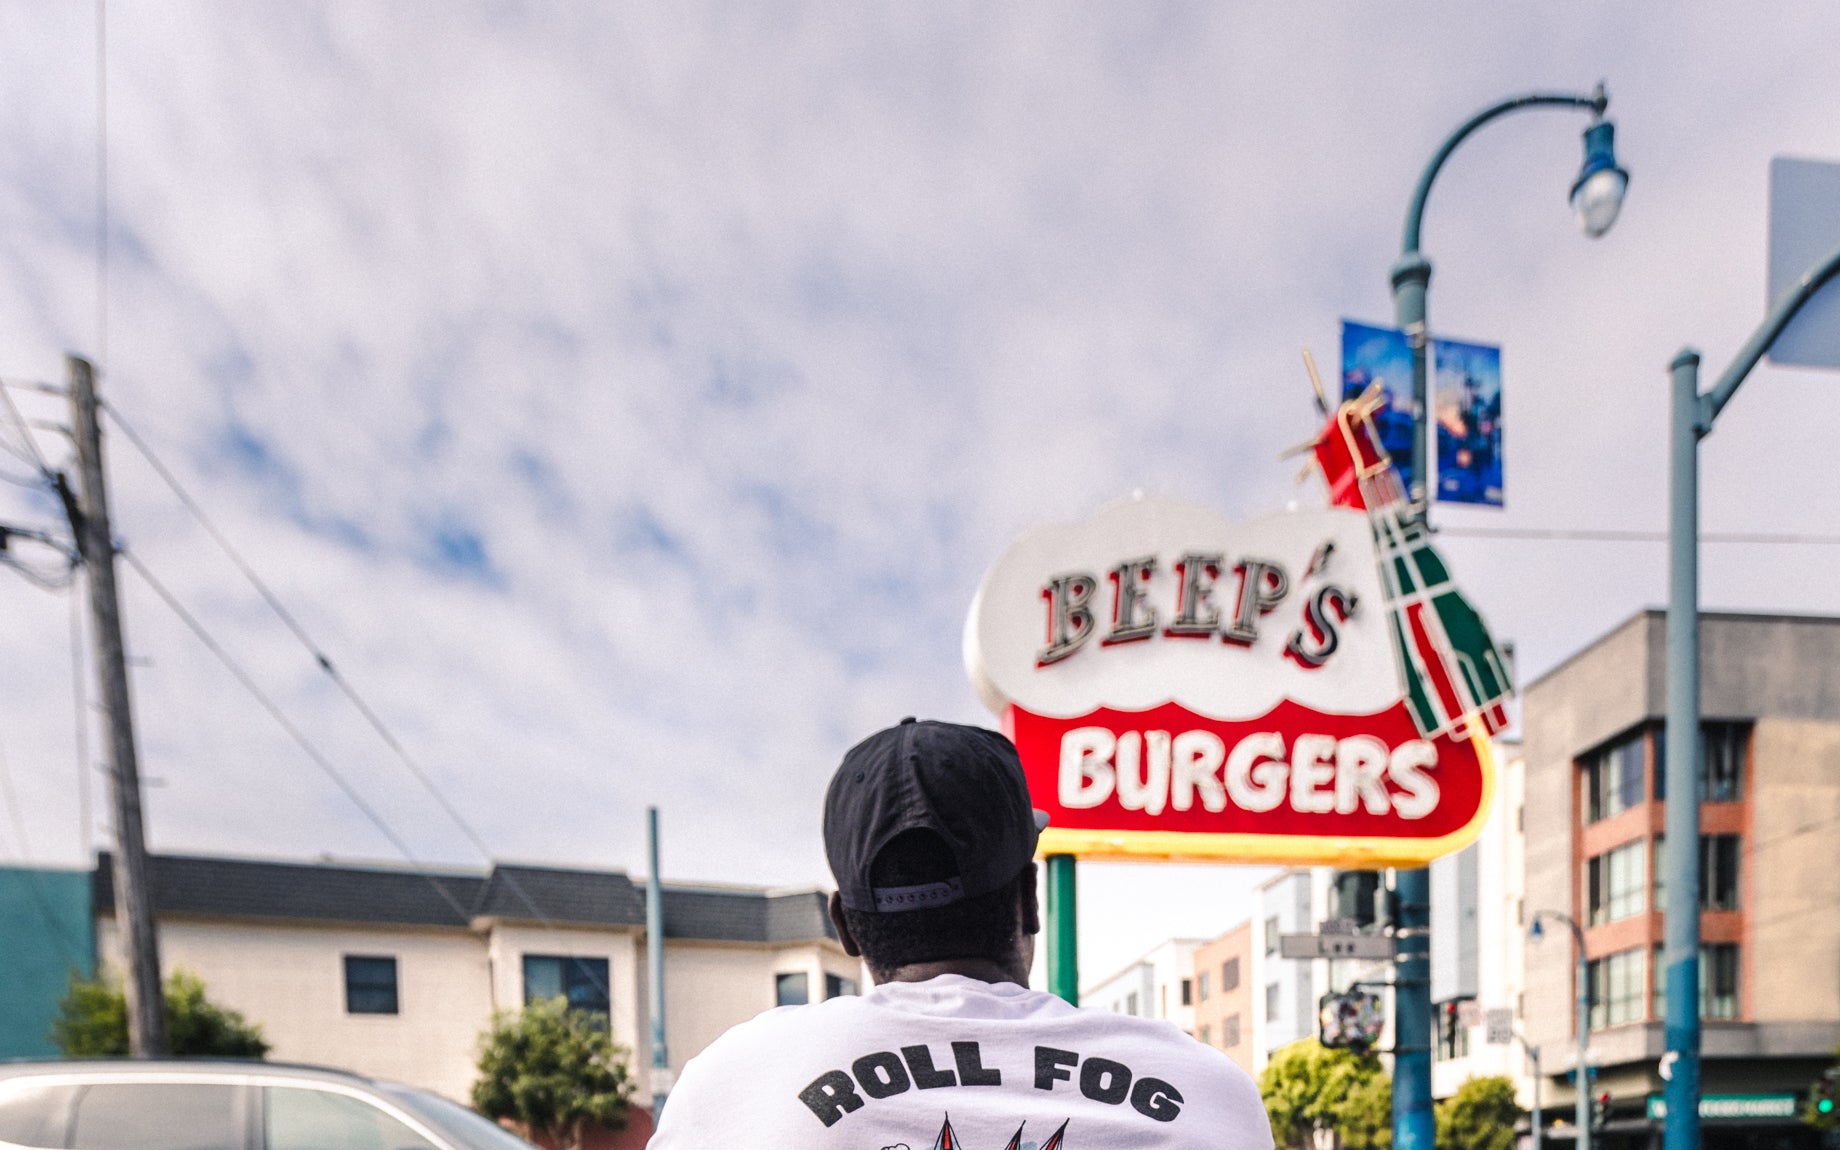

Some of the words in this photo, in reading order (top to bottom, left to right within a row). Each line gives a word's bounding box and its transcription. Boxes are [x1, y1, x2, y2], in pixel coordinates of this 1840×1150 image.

[1036, 541, 1360, 668] BEEP'S
[1058, 726, 1441, 819] BURGERS
[798, 1041, 1001, 1128] ROLL
[1034, 1046, 1185, 1123] FOG
